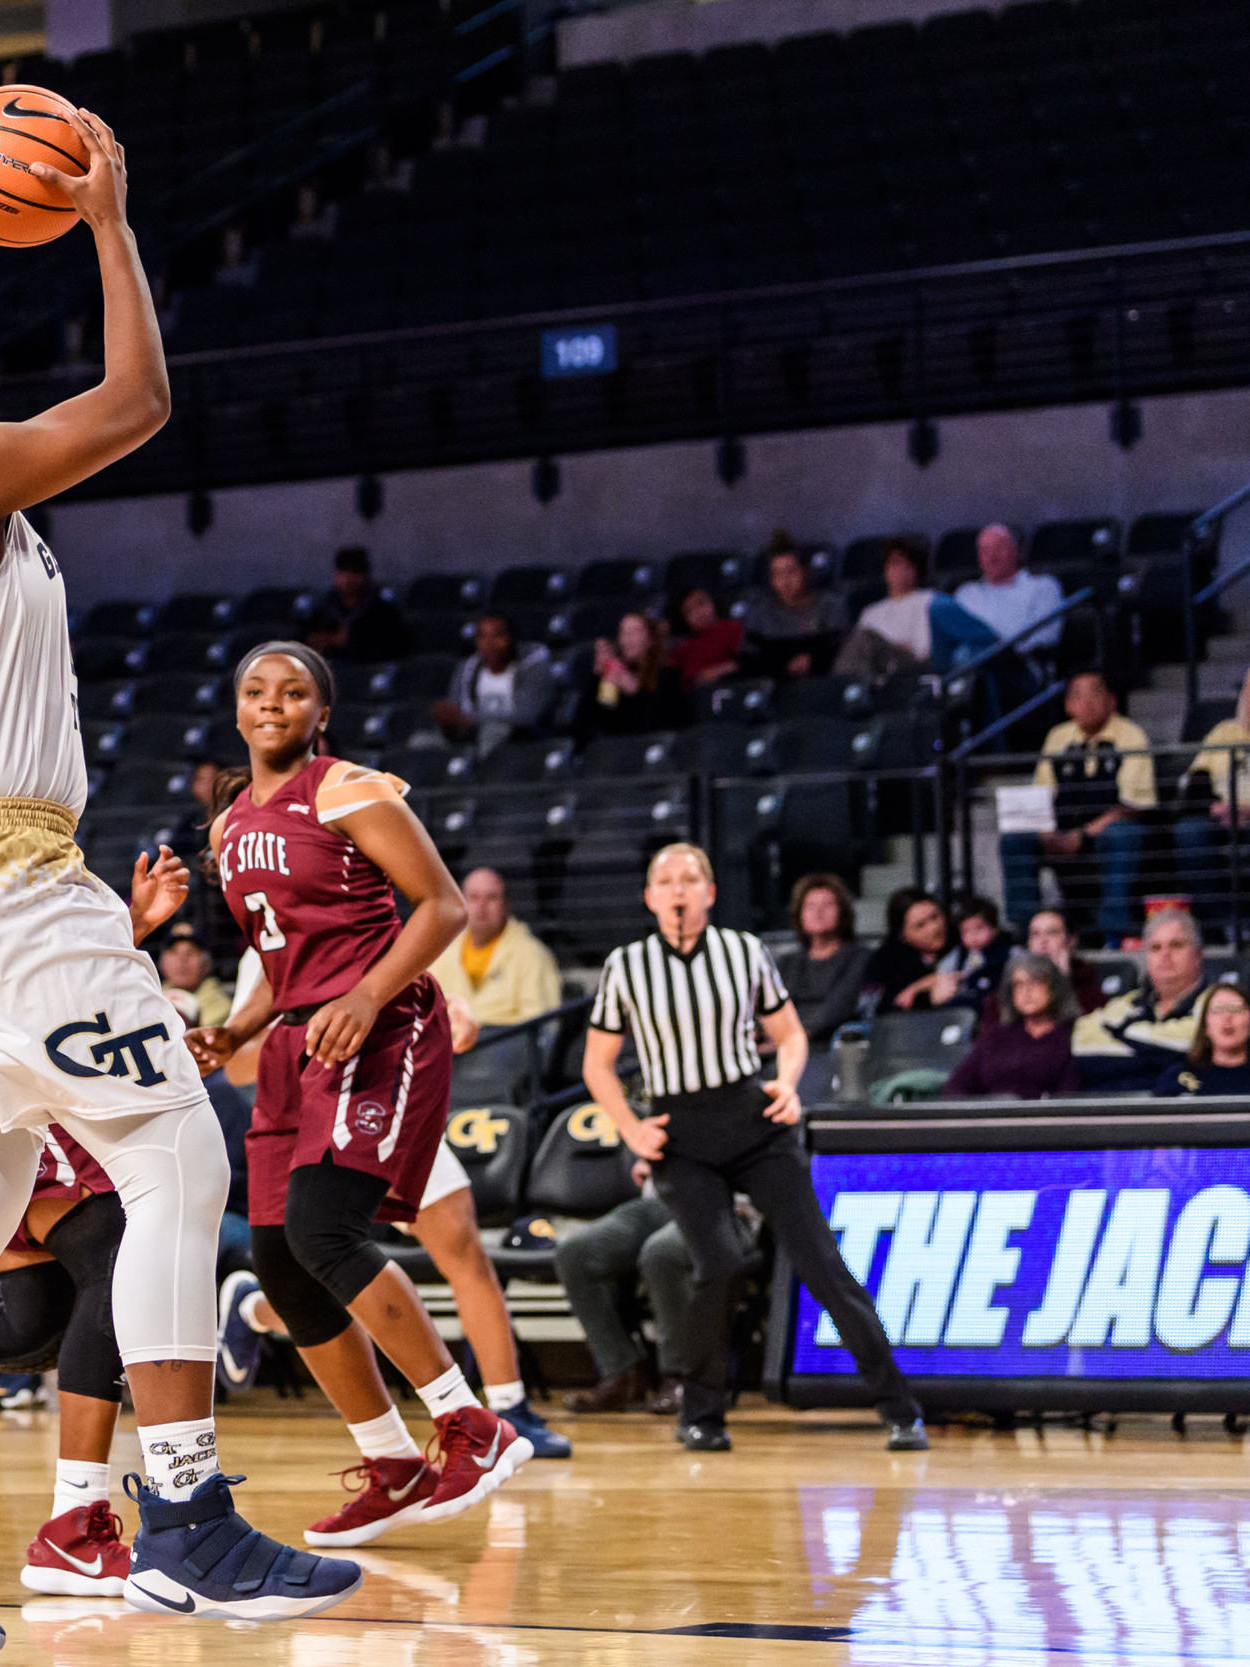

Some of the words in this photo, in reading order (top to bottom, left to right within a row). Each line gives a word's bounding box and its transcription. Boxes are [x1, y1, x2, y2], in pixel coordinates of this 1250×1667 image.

[236, 831, 291, 877] STATE
[41, 1008, 171, 1088] GT
[816, 1190, 1038, 1347] THE
[1021, 1184, 1250, 1353] JAC
